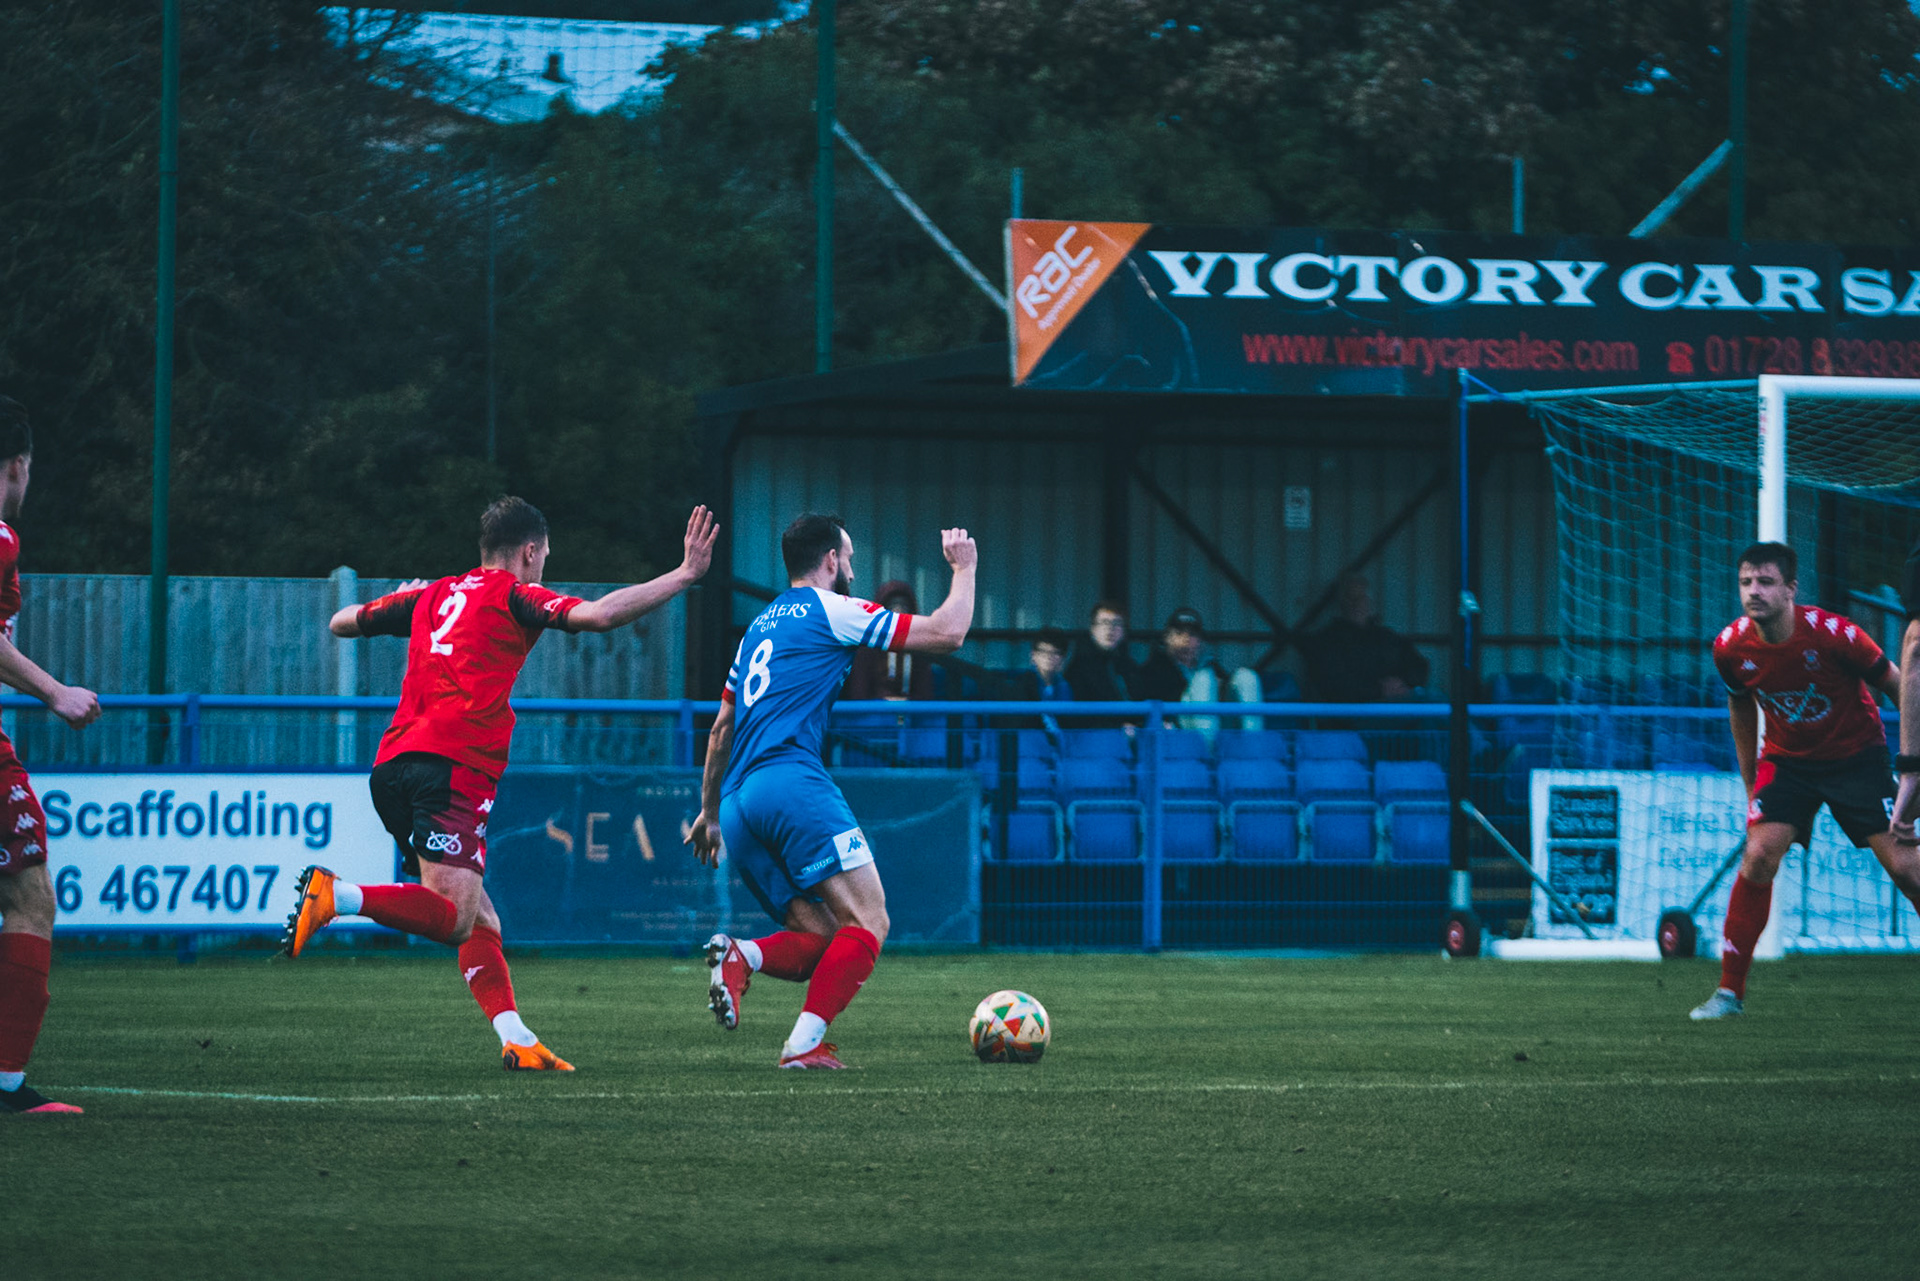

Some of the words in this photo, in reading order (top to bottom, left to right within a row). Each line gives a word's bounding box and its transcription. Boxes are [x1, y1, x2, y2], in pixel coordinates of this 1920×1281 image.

[1147, 249, 1609, 307] VICTORY
[1618, 261, 1826, 313] CAR
[1242, 328, 1640, 376] www.victorycarsales.com
[430, 591, 467, 656] 2
[760, 620, 778, 633] GIN
[743, 638, 774, 708] 8
[41, 789, 333, 849] Scaffolding
[55, 864, 83, 913] 6
[99, 864, 280, 914] 467407
